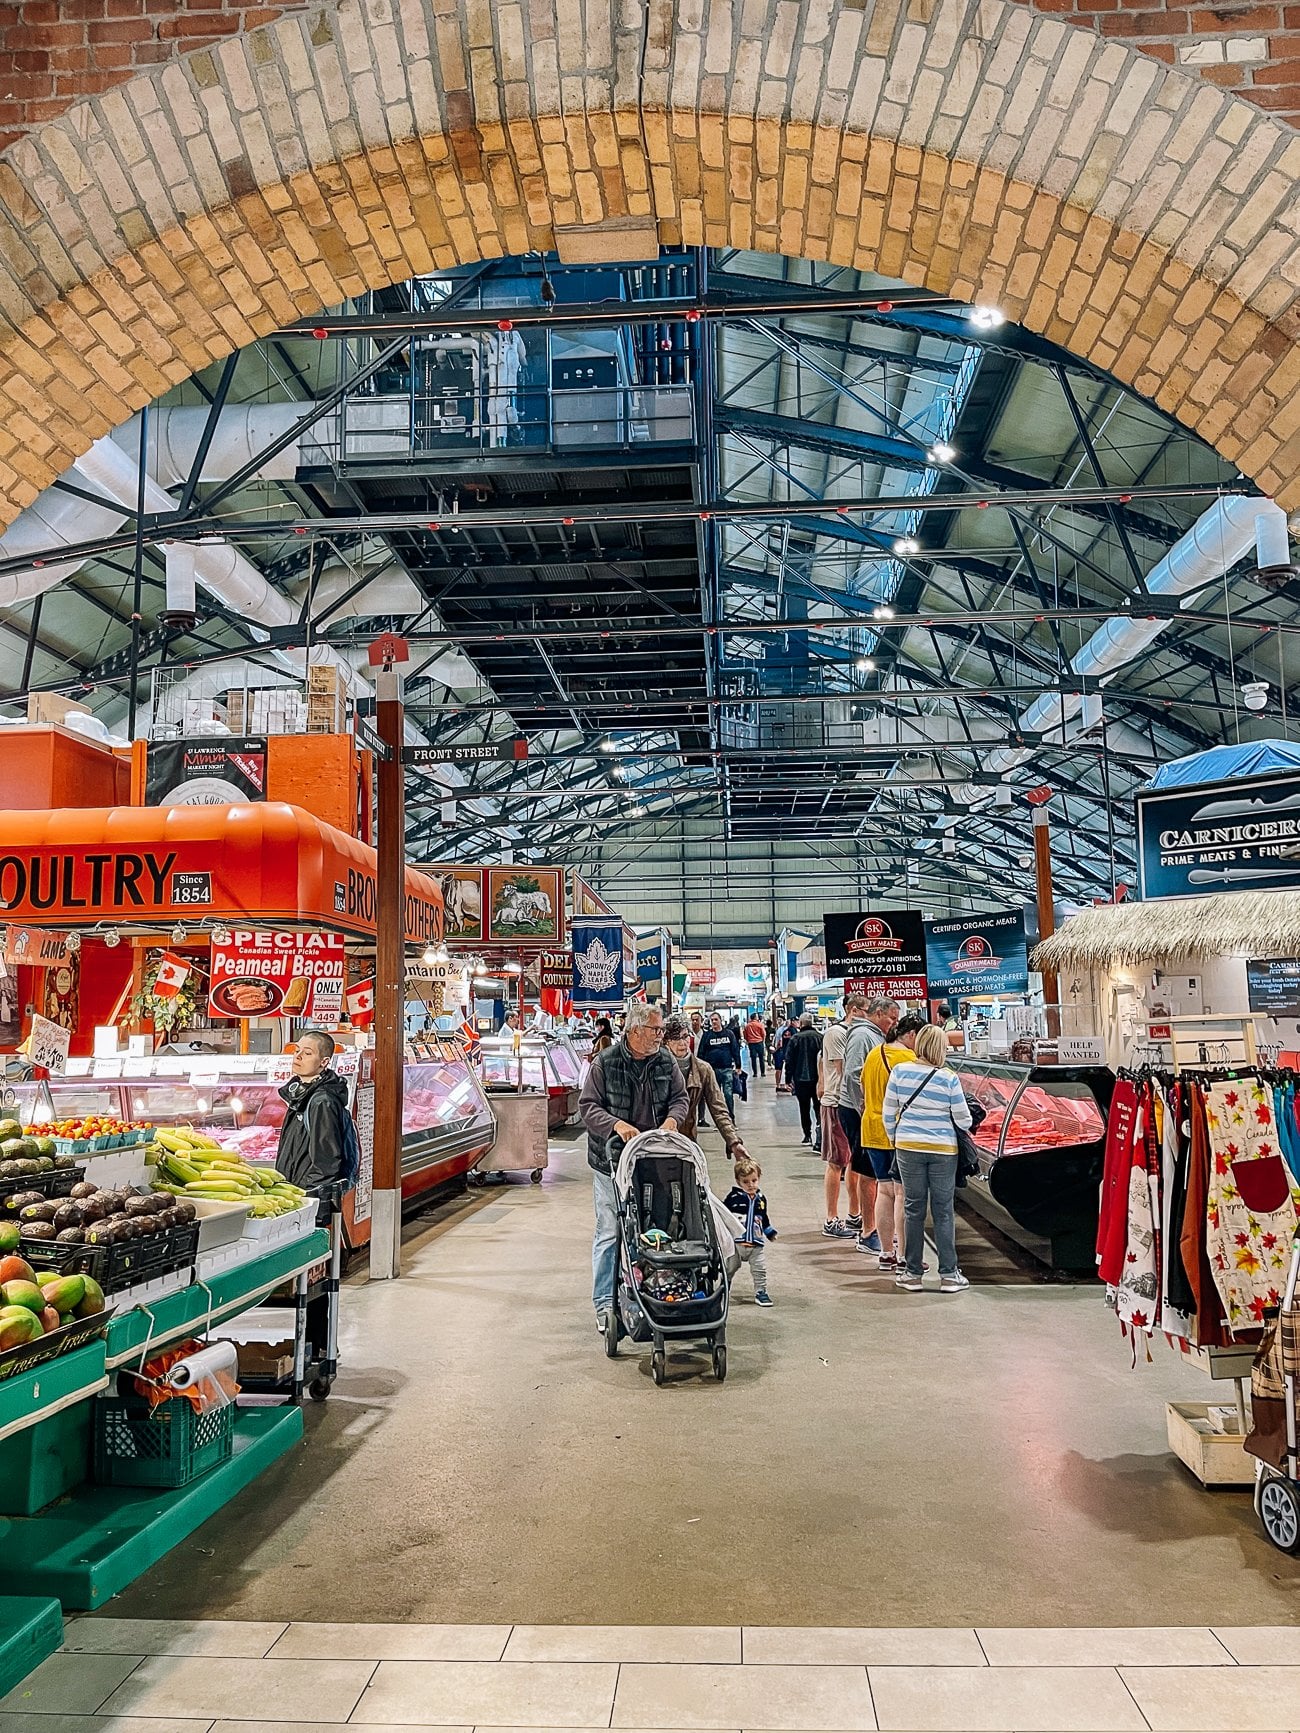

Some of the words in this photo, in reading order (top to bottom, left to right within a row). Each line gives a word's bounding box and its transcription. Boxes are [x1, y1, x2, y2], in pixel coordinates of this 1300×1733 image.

[414, 749, 452, 760] FRONT
[455, 746, 499, 759] STREET
[1159, 818, 1300, 849] CARNICER
[1160, 854, 1195, 866] PRIME
[1199, 850, 1236, 863] MEATS
[1242, 848, 1252, 859] &
[179, 875, 204, 884] Since
[173, 887, 210, 903] 1854
[865, 924, 881, 933] SK
[932, 924, 961, 934] CERTIFIED
[962, 919, 994, 930] ORGANIC
[995, 916, 1017, 926] MEATS
[212, 931, 344, 949] SPECIAL
[850, 940, 877, 949] QUALITY
[877, 940, 898, 948] MEATS
[39, 939, 67, 960] LAMB
[238, 947, 272, 955] Canadian
[274, 947, 296, 955] Sweet
[297, 947, 320, 955] Pickle
[968, 942, 982, 953] SK
[213, 952, 287, 976] Peameal
[291, 954, 344, 977] Bacon
[543, 953, 573, 969] DEL
[841, 957, 876, 965] HORMONES
[886, 955, 922, 963] ANTIBIOTICS
[954, 959, 978, 969] QUALITY
[583, 962, 612, 971] TORONTO
[847, 964, 907, 974] 416-777-0181
[542, 973, 574, 986] COUNTE
[849, 982, 866, 990] WE
[866, 981, 886, 990] ARE
[887, 980, 921, 989] TAKING
[930, 977, 965, 987] ANTIBIOTIC
[972, 972, 1024, 983] HORMONE-FREE
[316, 981, 342, 994] ONLY
[886, 988, 924, 997] ORDERS
[948, 985, 983, 994] GRASS-FED
[984, 982, 1006, 991] MEATS
[1070, 1041, 1093, 1049] HELP
[1062, 1051, 1100, 1059] WANTED
[337, 1065, 356, 1076] 699
[1245, 1126, 1274, 1139] Canada
